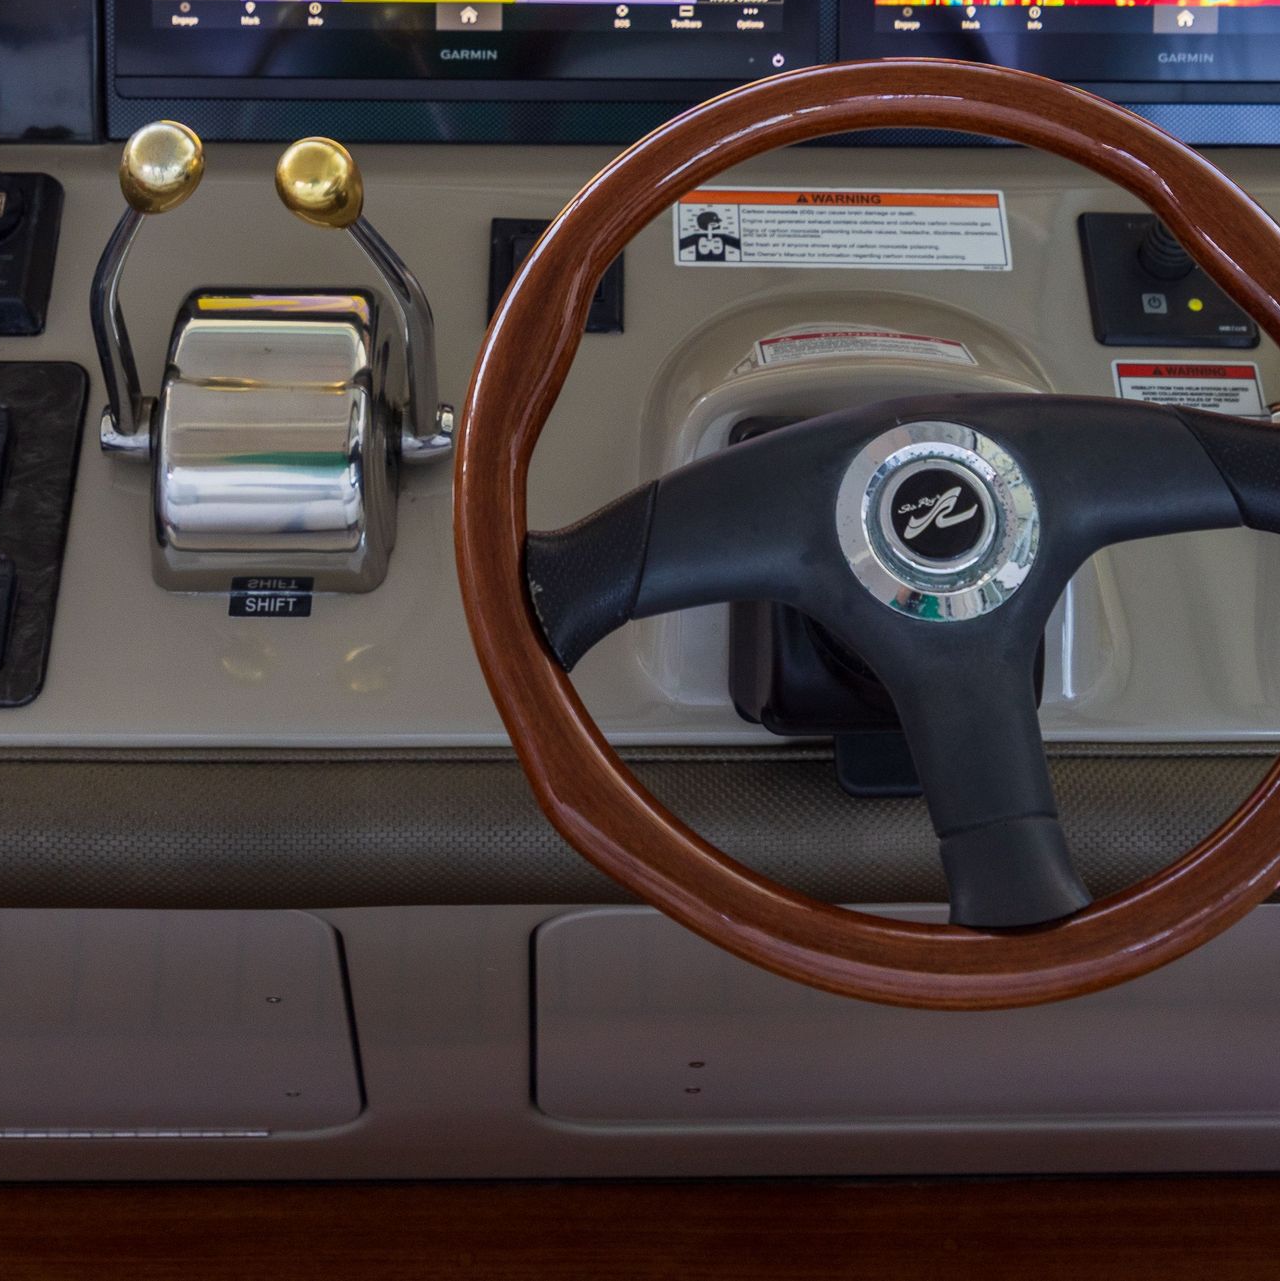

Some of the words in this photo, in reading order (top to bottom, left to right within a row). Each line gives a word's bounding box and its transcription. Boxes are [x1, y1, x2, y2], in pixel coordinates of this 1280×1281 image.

[440, 49, 498, 61] GARMIN
[1158, 52, 1214, 63] GARMIN
[811, 193, 882, 205] WARNING
[1166, 366, 1227, 377] WARNING
[244, 597, 297, 612] SHIFT
